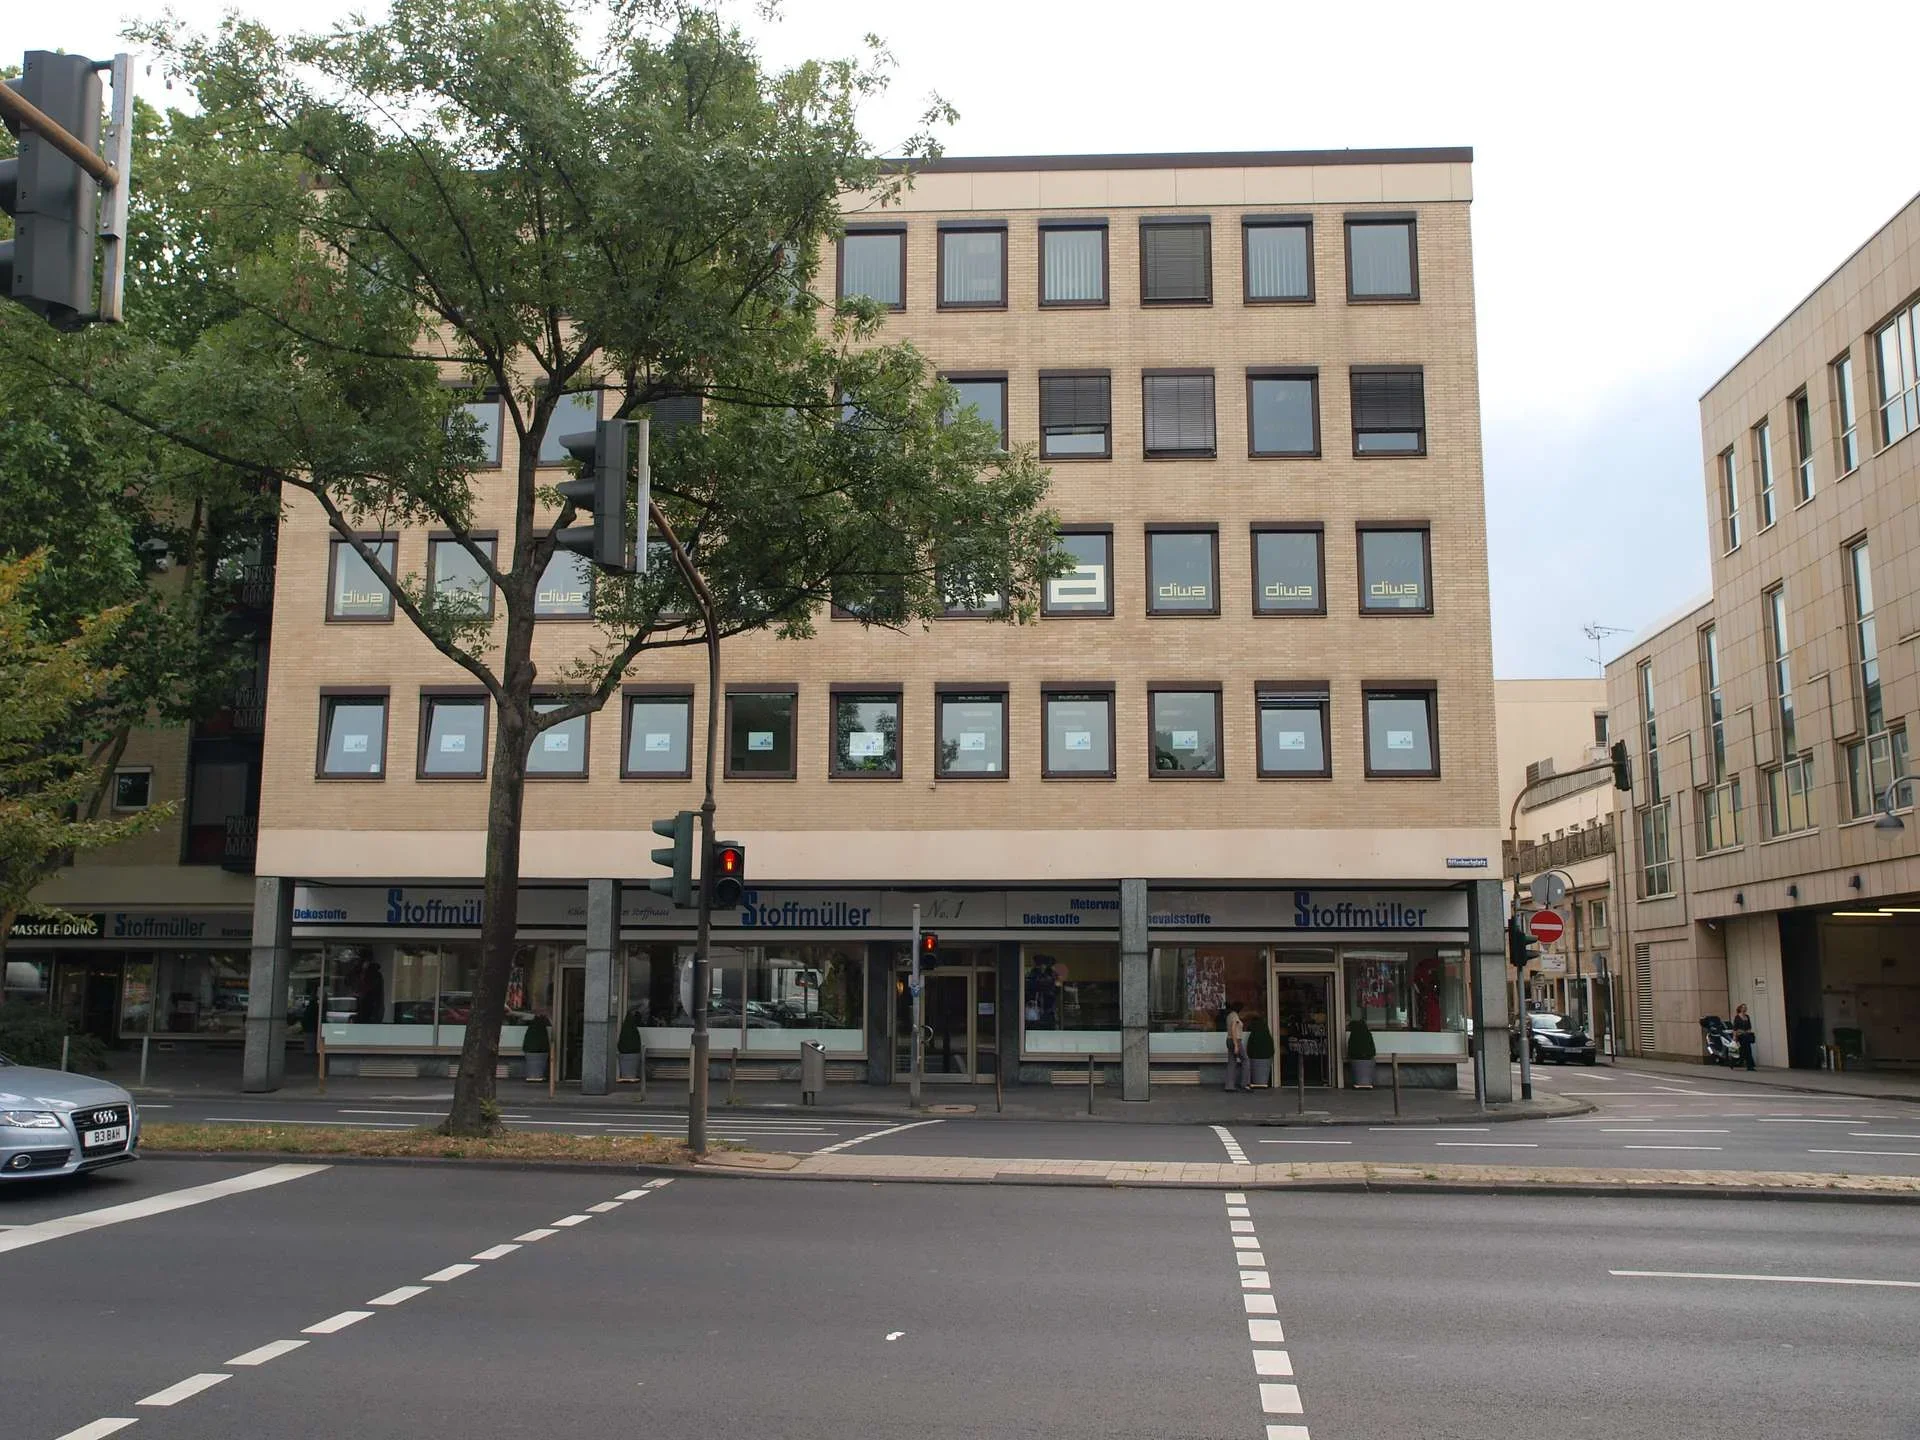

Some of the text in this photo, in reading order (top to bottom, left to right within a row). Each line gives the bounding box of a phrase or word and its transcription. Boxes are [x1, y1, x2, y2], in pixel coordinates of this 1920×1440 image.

[1159, 583, 1206, 596] diwa
[1265, 582, 1312, 596] diwa
[1370, 581, 1418, 594] diwa
[340, 590, 384, 602] diwa
[539, 589, 583, 601] diwa
[293, 908, 347, 920] Dekostoffe
[741, 891, 871, 925] Stoffmüller
[1294, 891, 1427, 926] Stoffmüller
[114, 912, 207, 936] Stoffmüller
[1023, 913, 1080, 925] Dekostoffe
[94, 1128, 121, 1143] B3 BAH
